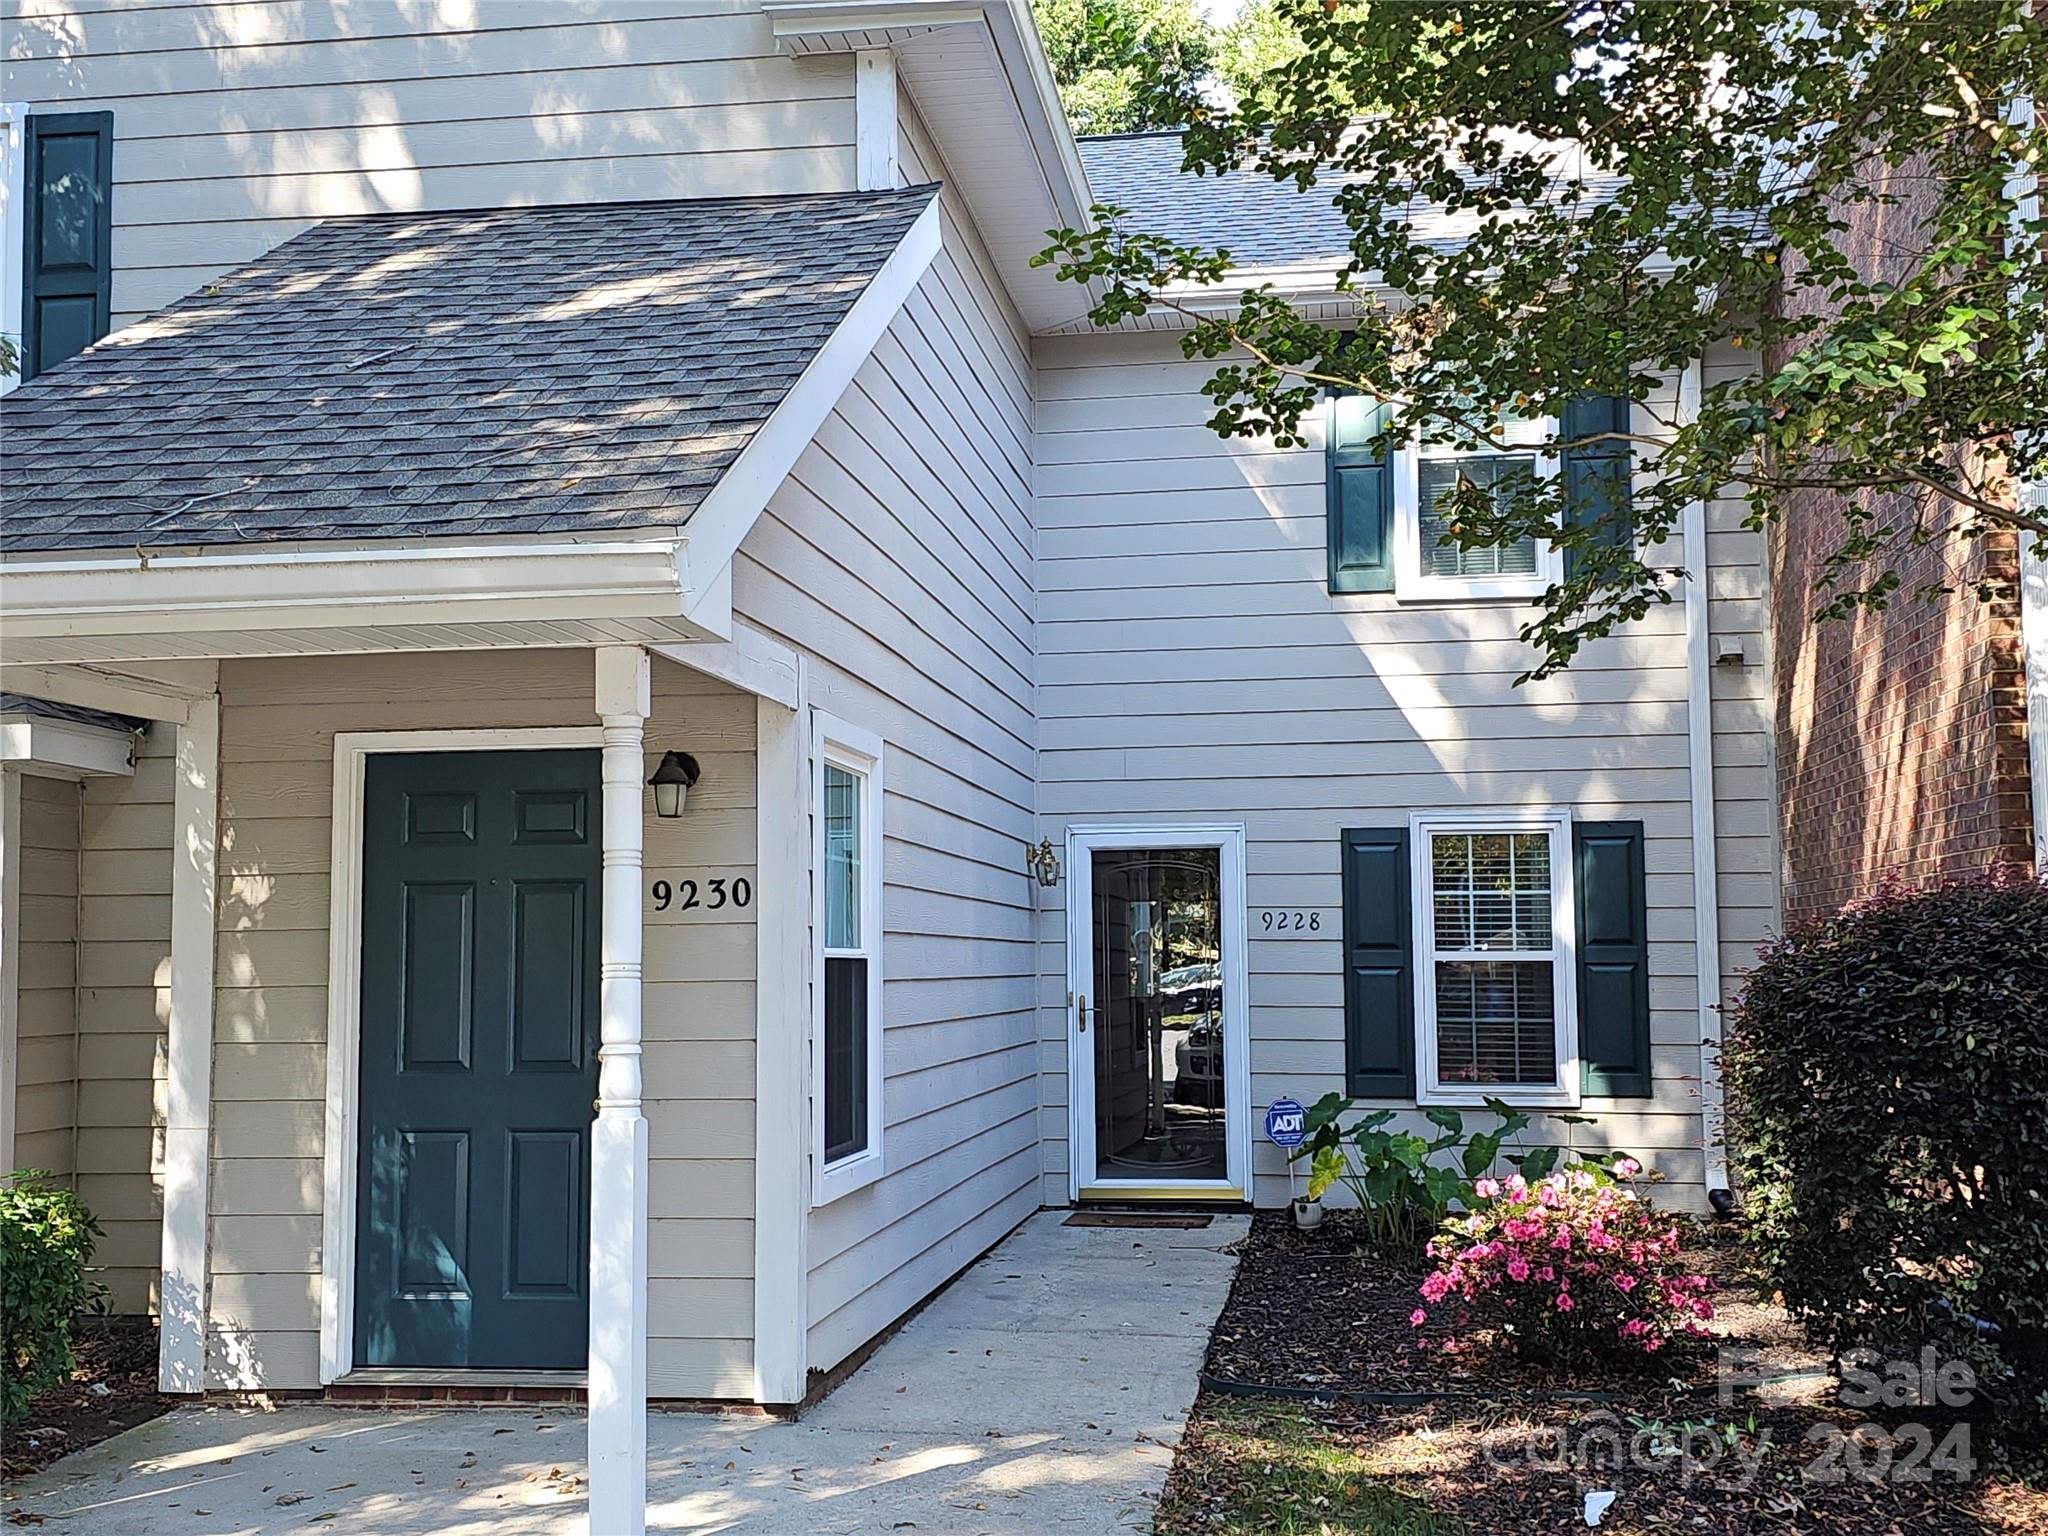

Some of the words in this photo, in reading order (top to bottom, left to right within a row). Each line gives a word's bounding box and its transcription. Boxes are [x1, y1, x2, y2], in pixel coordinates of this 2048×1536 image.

[652, 877, 751, 911] 9230
[1262, 911, 1320, 931] 9228
[1273, 1114, 1303, 1132] ADT
